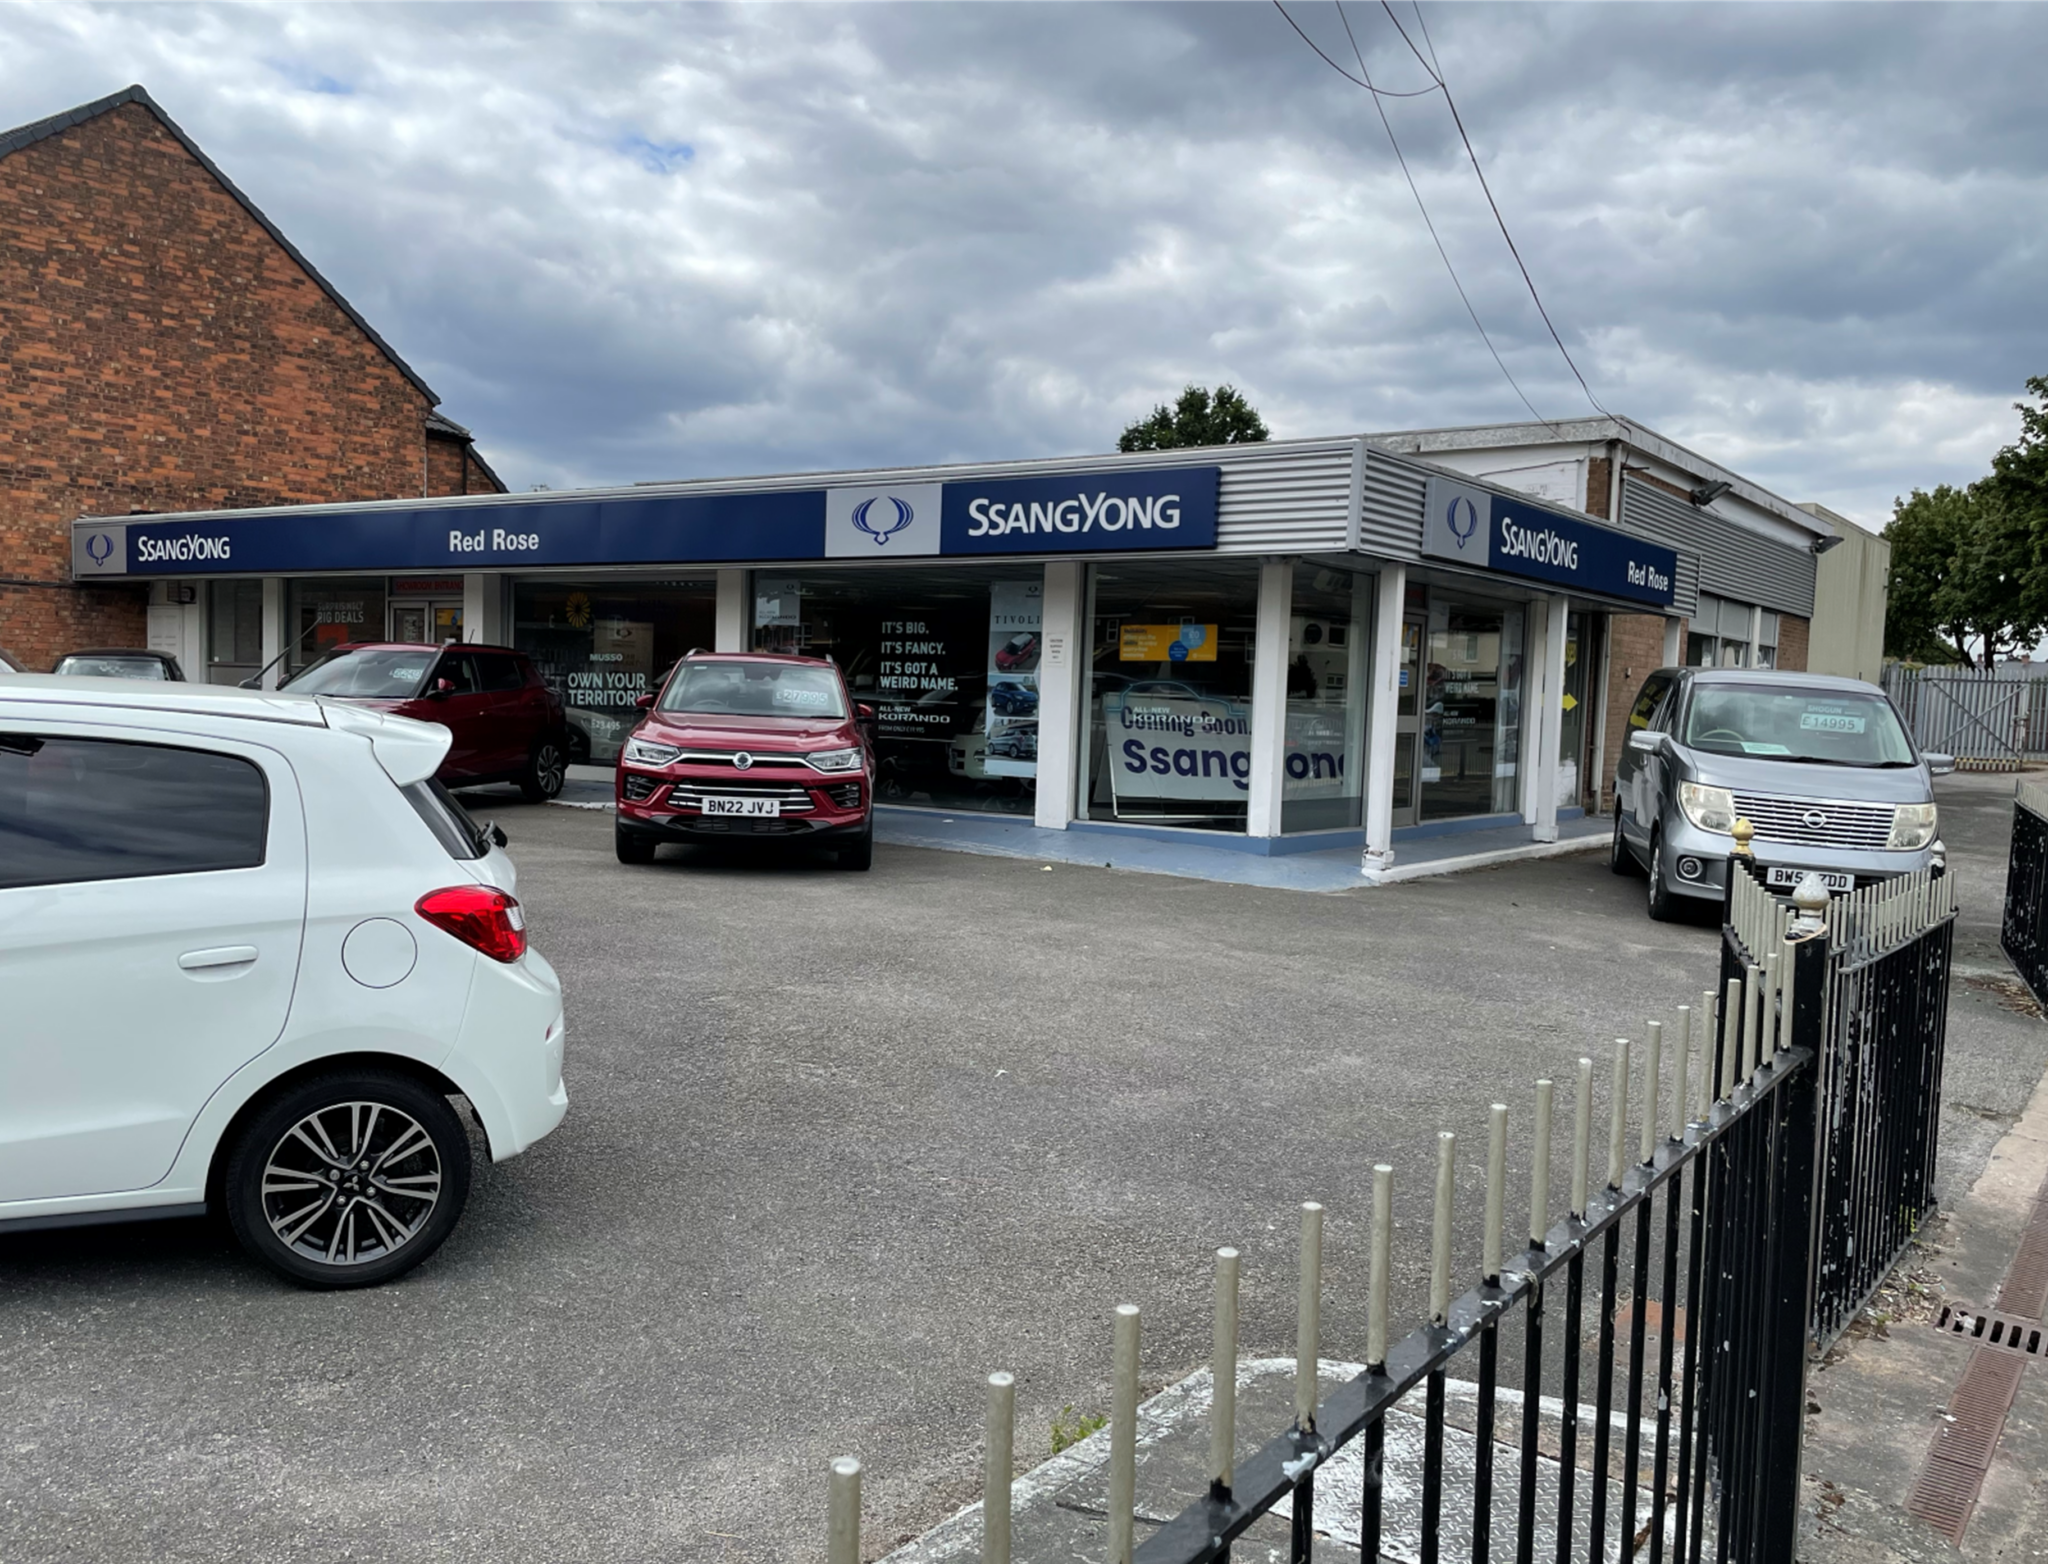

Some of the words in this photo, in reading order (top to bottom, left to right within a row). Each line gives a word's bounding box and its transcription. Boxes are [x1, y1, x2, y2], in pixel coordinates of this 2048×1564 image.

[449, 529, 485, 552] Red
[492, 528, 540, 551] Rose
[1627, 560, 1646, 587] Red
[1647, 566, 1669, 592] Rose
[434, 579, 464, 591] ENTRANC
[334, 611, 365, 624] DEALS
[994, 615, 1041, 625] TIVOLI
[882, 621, 903, 634] IT'S
[905, 622, 930, 635] BIG.
[881, 641, 903, 655] IT'S
[905, 641, 946, 655] FANCY.
[589, 653, 624, 662] MUSSO
[880, 661, 902, 675] IT'S
[904, 662, 928, 676] GOT
[929, 663, 939, 676] A
[567, 672, 603, 689] OWN
[605, 672, 646, 690] YOUR
[880, 676, 918, 689] WEIRD
[920, 677, 959, 691] NAME.
[1132, 706, 1171, 714] ALL-NEW
[878, 713, 951, 724] KORANDO
[1802, 716, 1856, 731] £14995
[708, 799, 744, 814] BN22
[747, 801, 774, 815] JVJ
